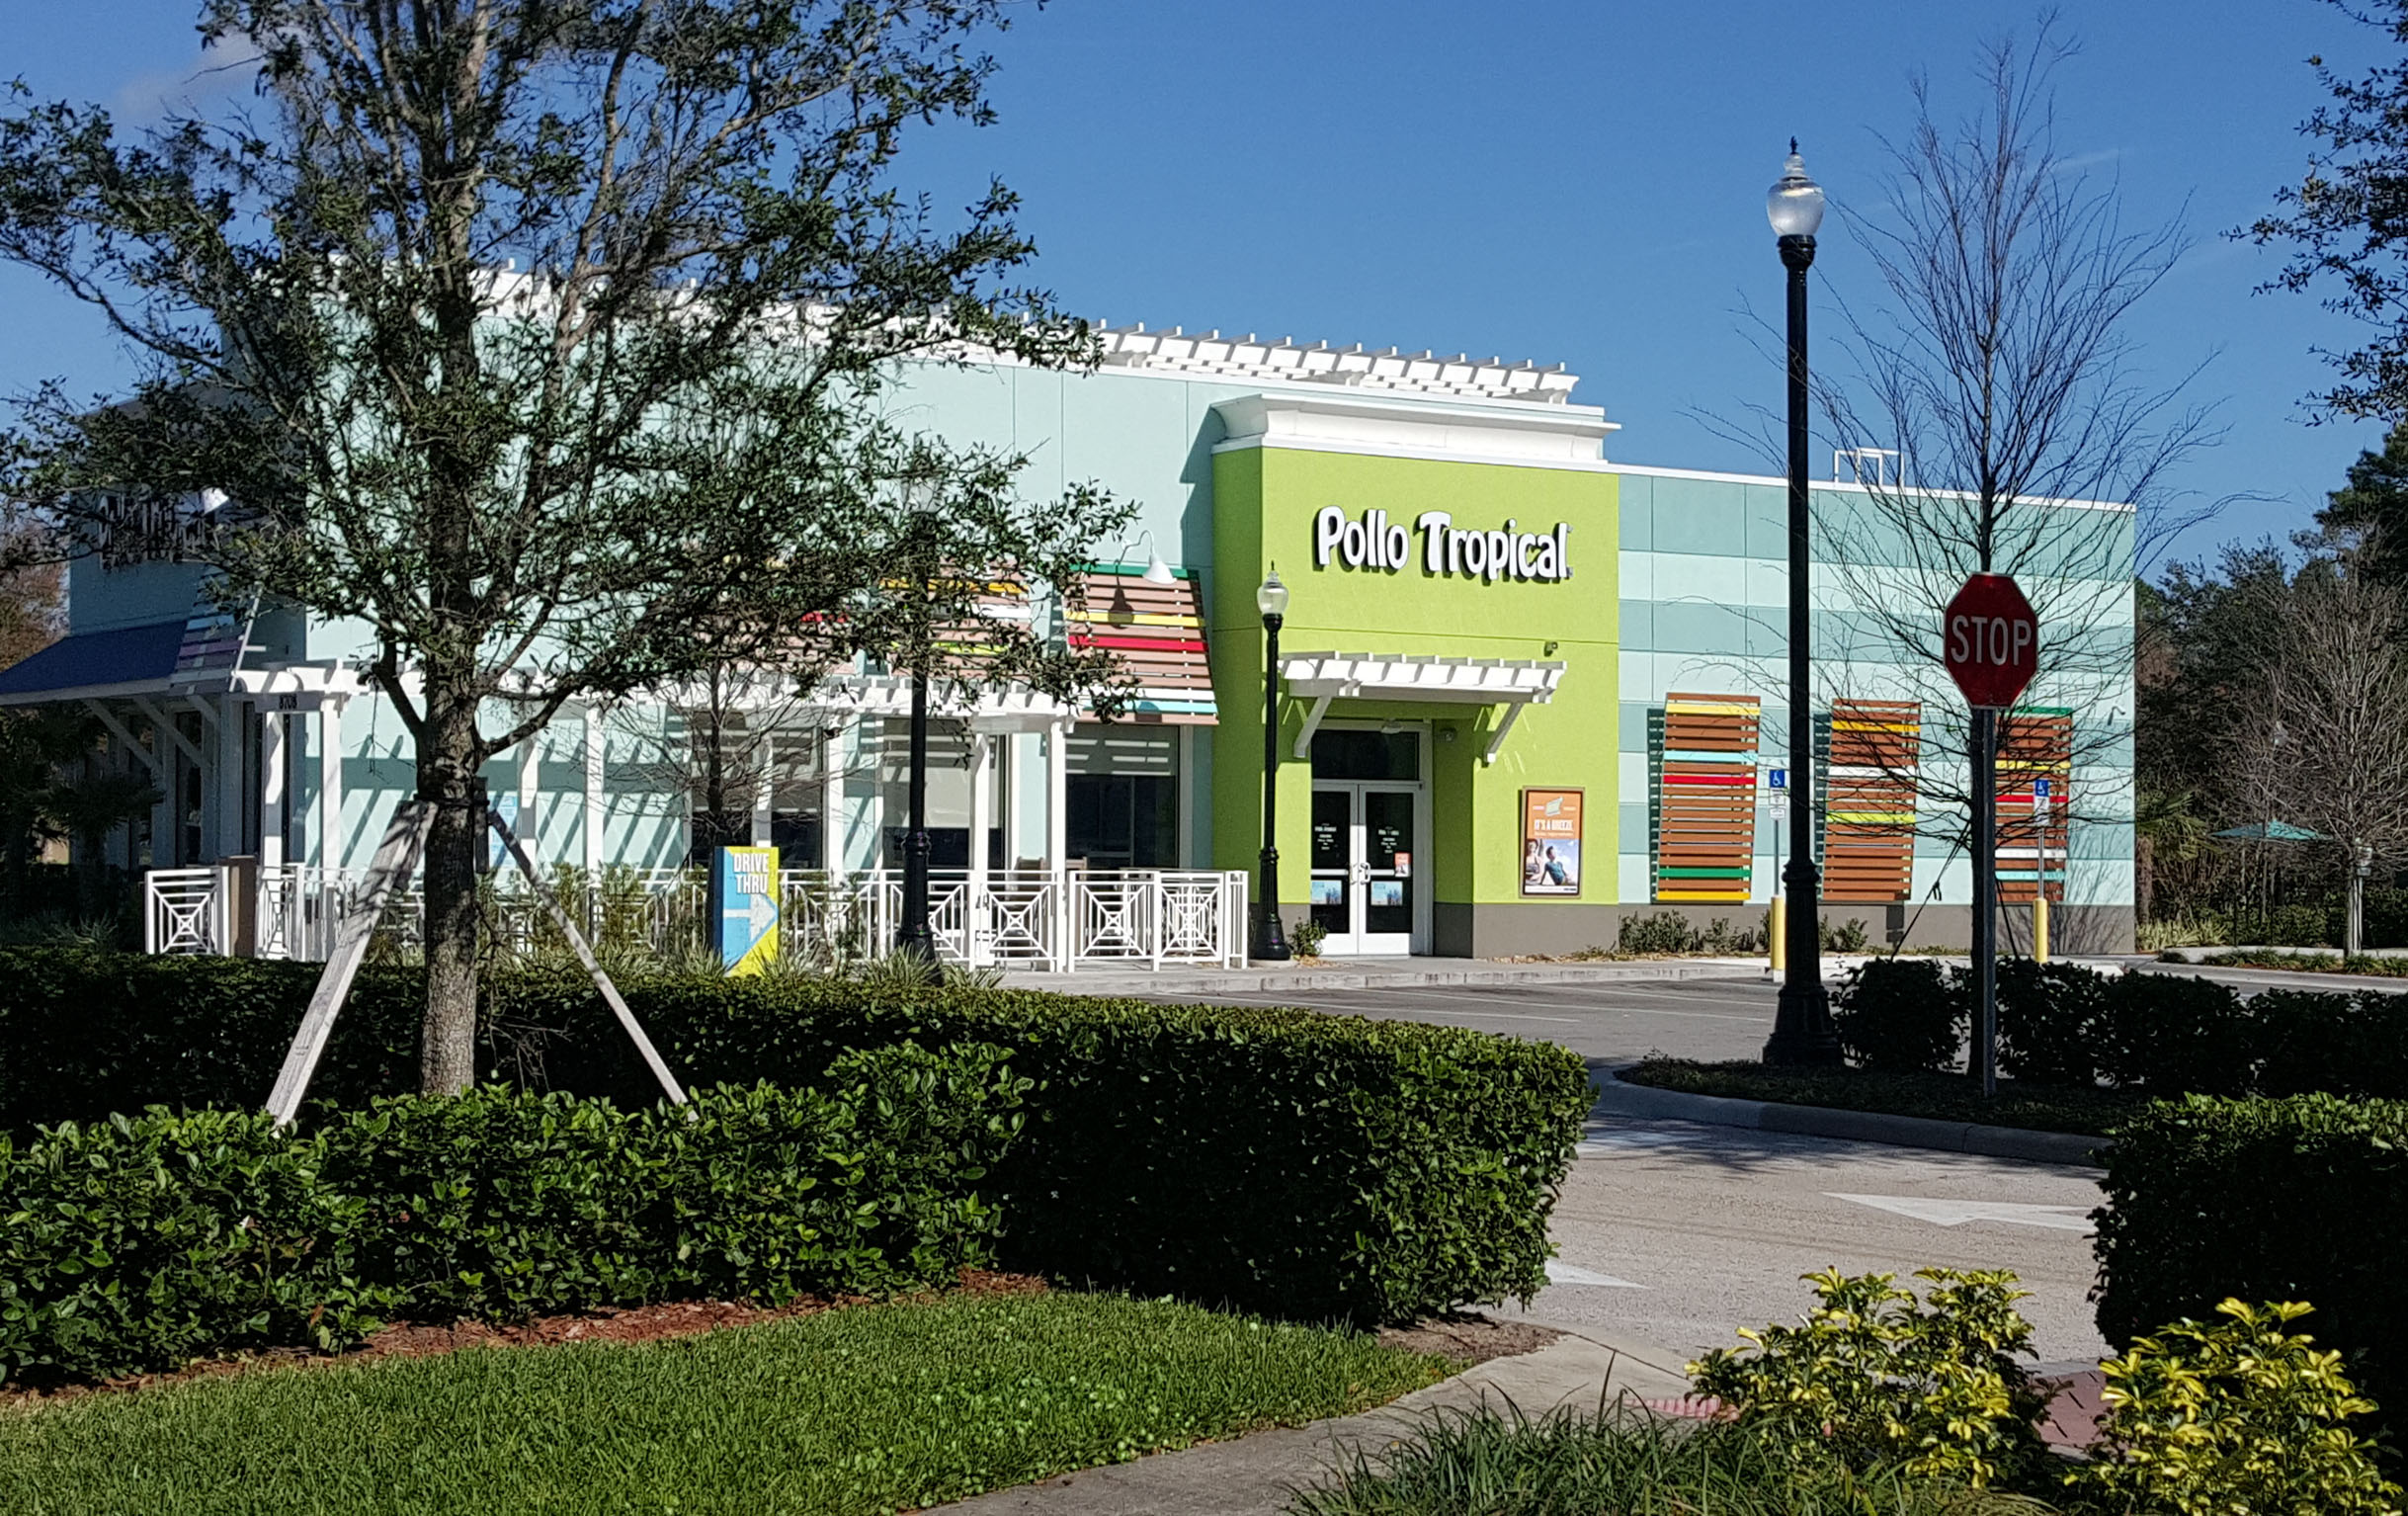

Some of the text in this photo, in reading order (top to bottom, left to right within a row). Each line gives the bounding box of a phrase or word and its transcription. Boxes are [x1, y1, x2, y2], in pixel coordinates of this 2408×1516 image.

[1313, 505, 1569, 586] Pollo Tropical
[1951, 615, 2033, 666] STOP
[733, 853, 769, 873] DRIVE
[735, 874, 769, 894] THRU
